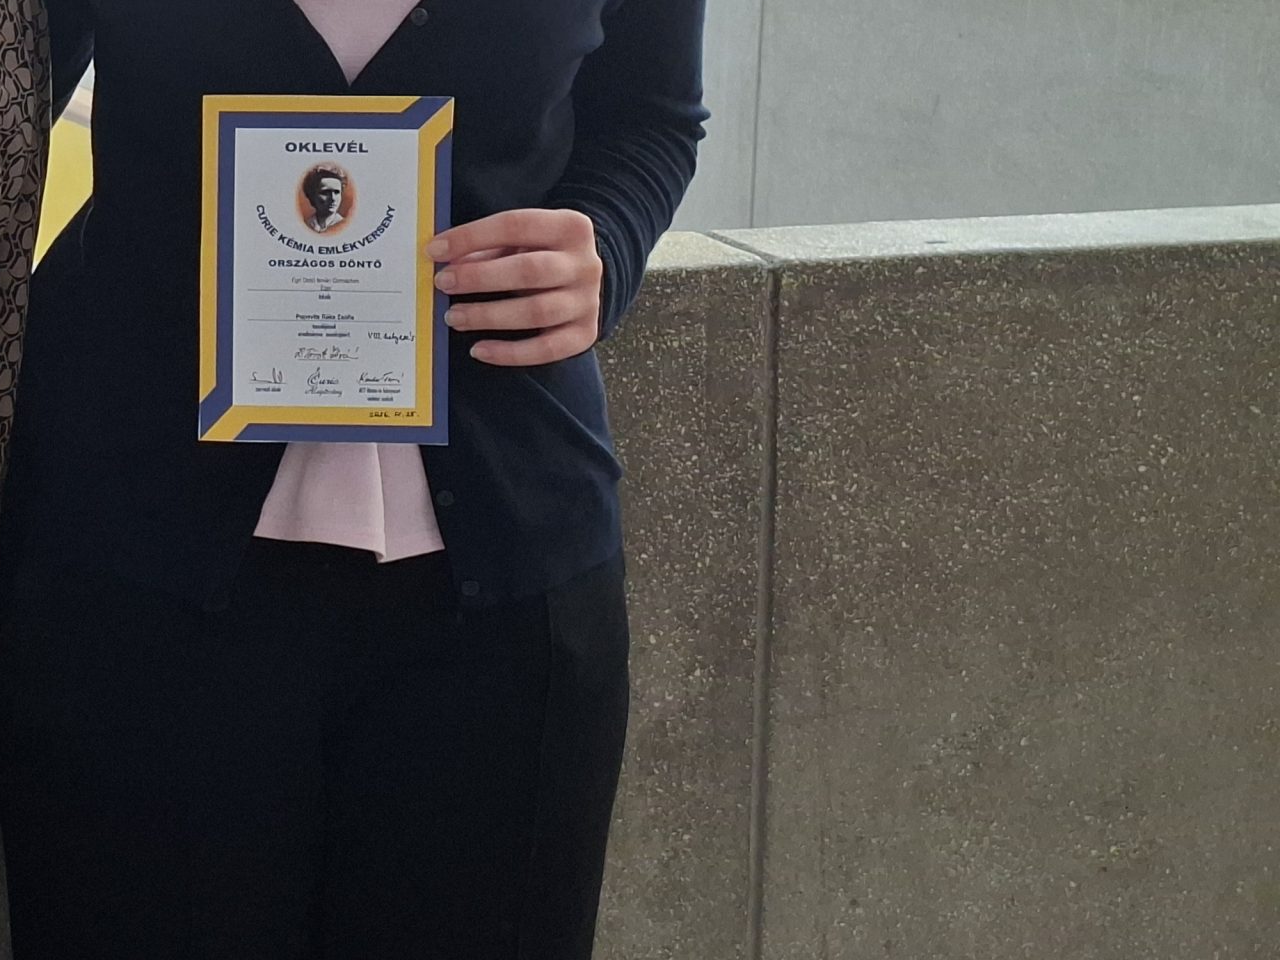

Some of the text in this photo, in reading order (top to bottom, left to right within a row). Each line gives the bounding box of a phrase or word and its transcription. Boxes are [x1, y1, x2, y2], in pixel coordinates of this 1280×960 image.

[285, 140, 369, 154] OKLEVÉL
[256, 204, 396, 255] CURIE KÉMIA EMLÉKVERSENY
[268, 258, 382, 269] ORSZÁGOS DÖNTŐ
